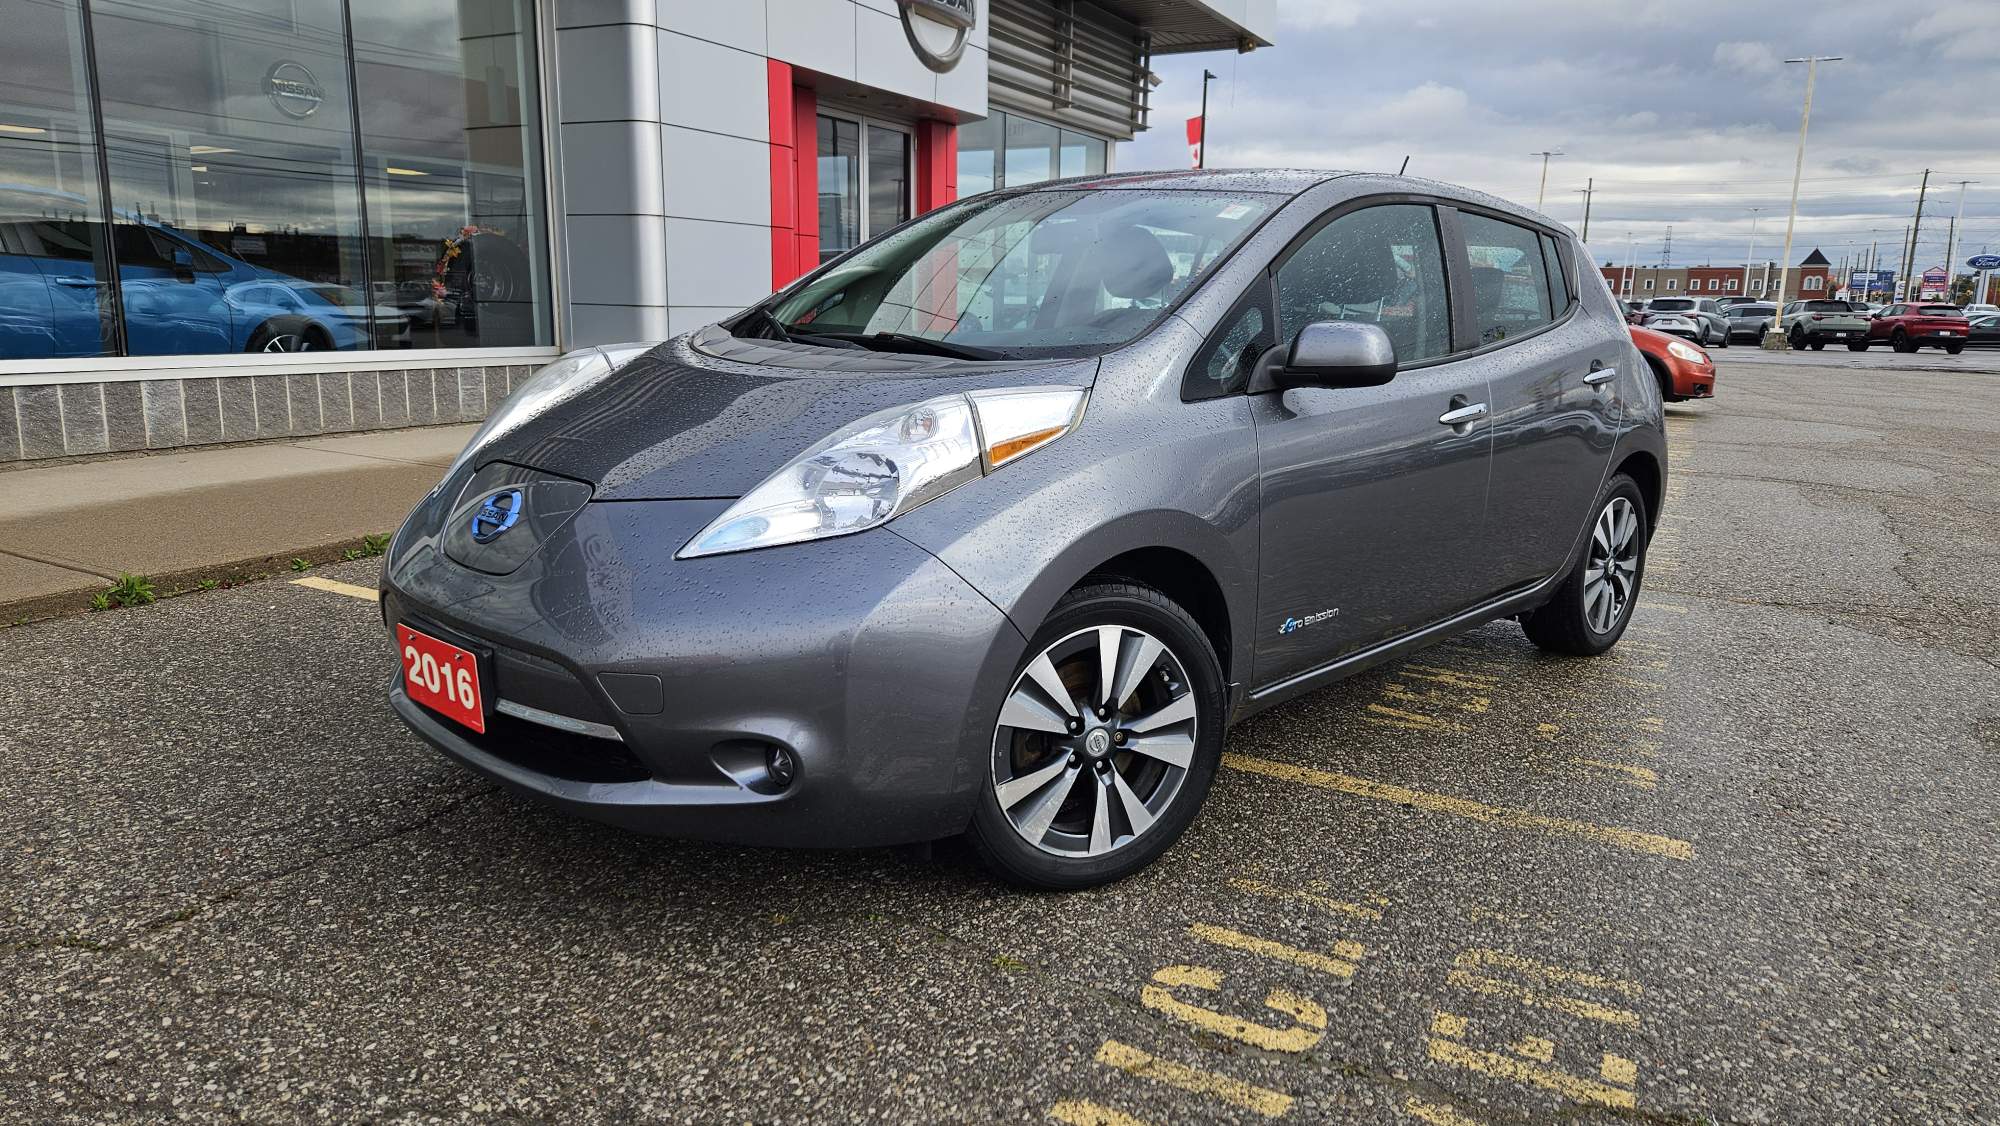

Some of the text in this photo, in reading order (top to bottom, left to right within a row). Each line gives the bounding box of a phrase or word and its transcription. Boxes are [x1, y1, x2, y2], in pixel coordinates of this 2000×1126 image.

[1975, 258, 2000, 267] Ford
[1304, 607, 1339, 625] Emission
[405, 645, 475, 710] 2016
